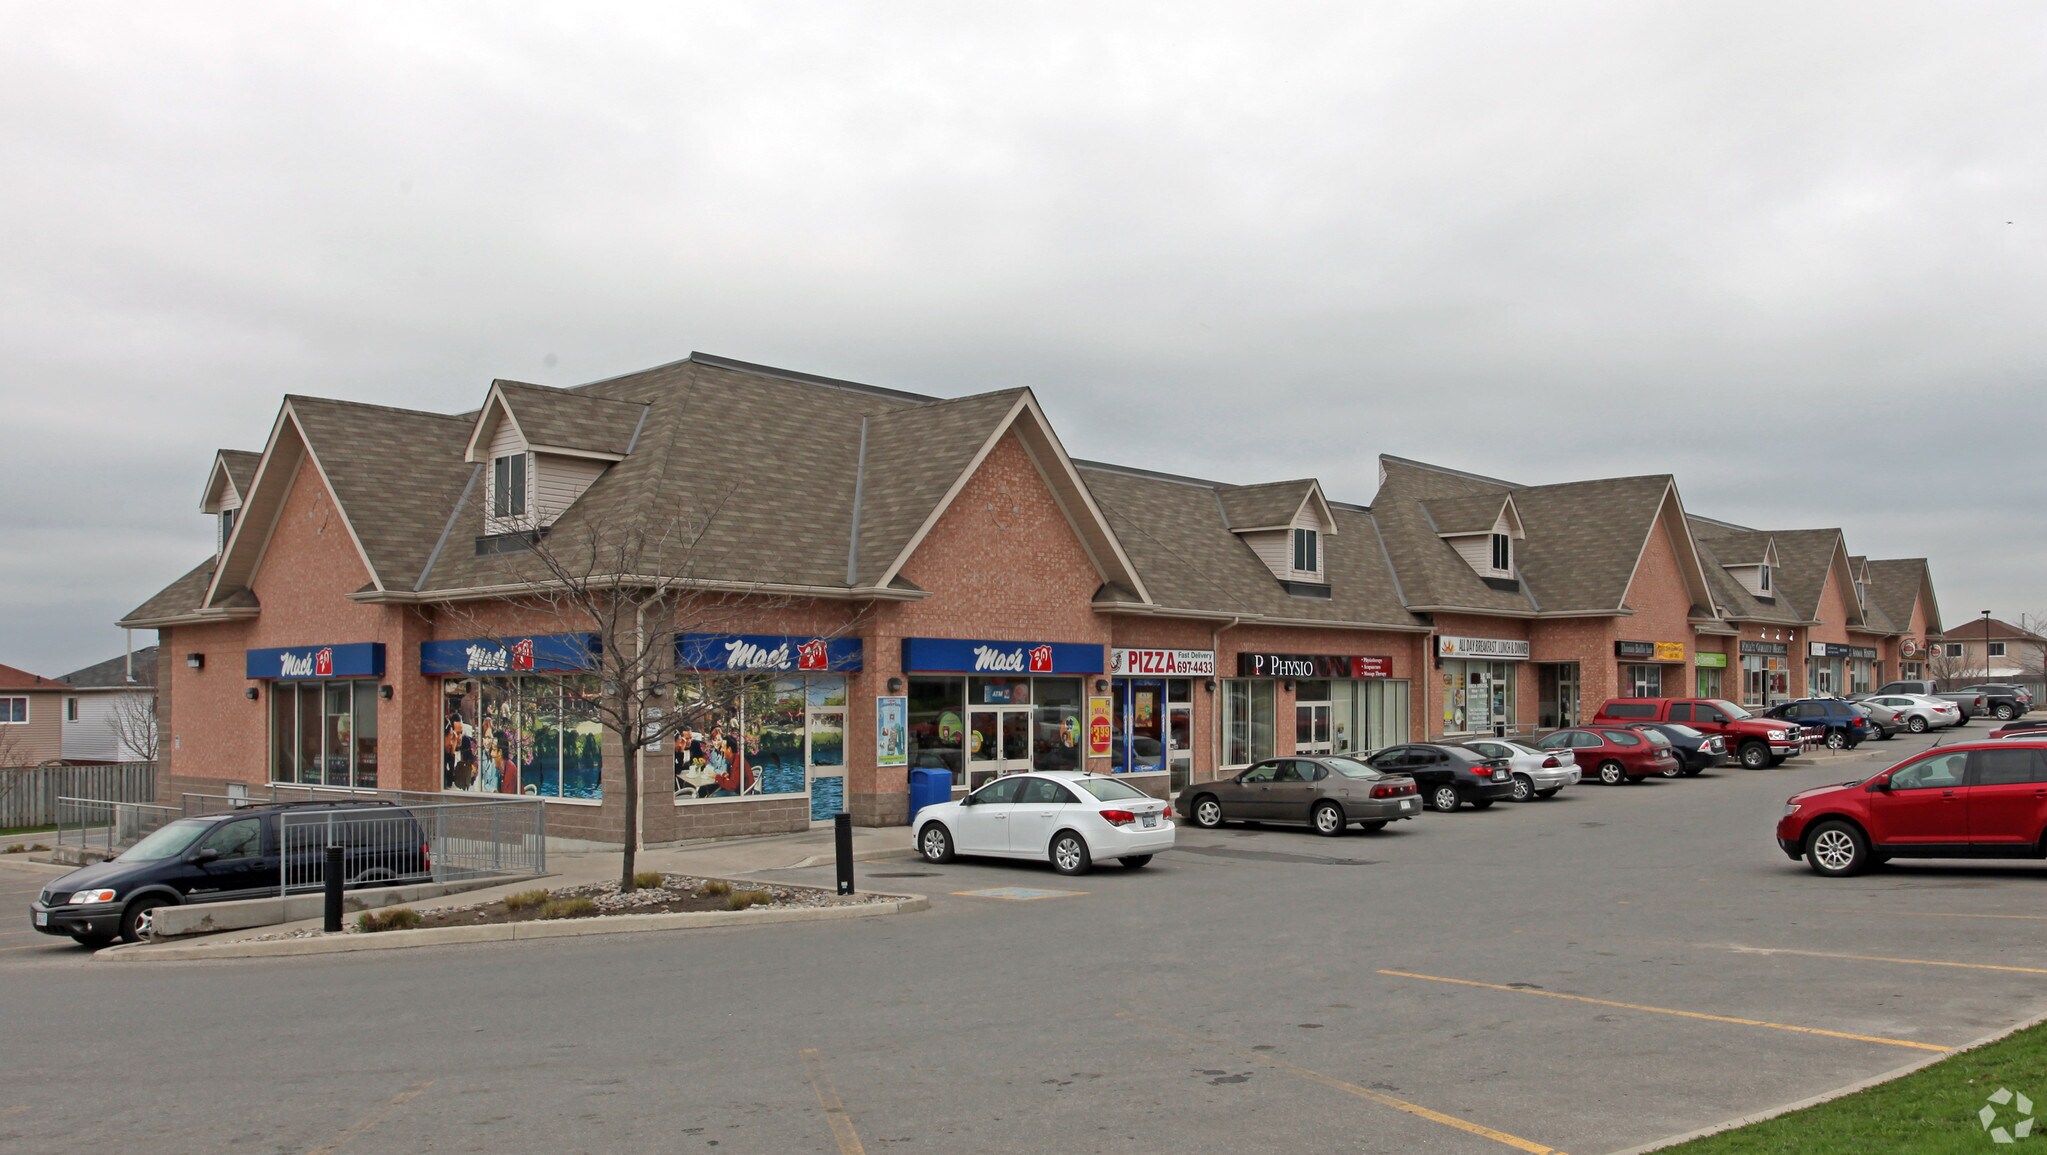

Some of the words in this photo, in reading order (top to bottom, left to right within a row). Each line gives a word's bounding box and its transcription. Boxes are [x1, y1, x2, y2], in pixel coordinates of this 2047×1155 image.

[725, 639, 791, 669] Mac's
[1178, 651, 1190, 659] Fast
[1191, 652, 1212, 660] Delivery
[1466, 639, 1475, 652] DAY
[1498, 641, 1510, 653] LUNCH
[1514, 642, 1528, 654] DINNER
[280, 652, 312, 676] Mac's
[466, 644, 508, 672] Mac's
[974, 645, 1024, 671] Mac's
[1128, 651, 1176, 673] PIZZA
[1177, 661, 1213, 674] 697-4433
[1271, 655, 1313, 676] PHYSIO
